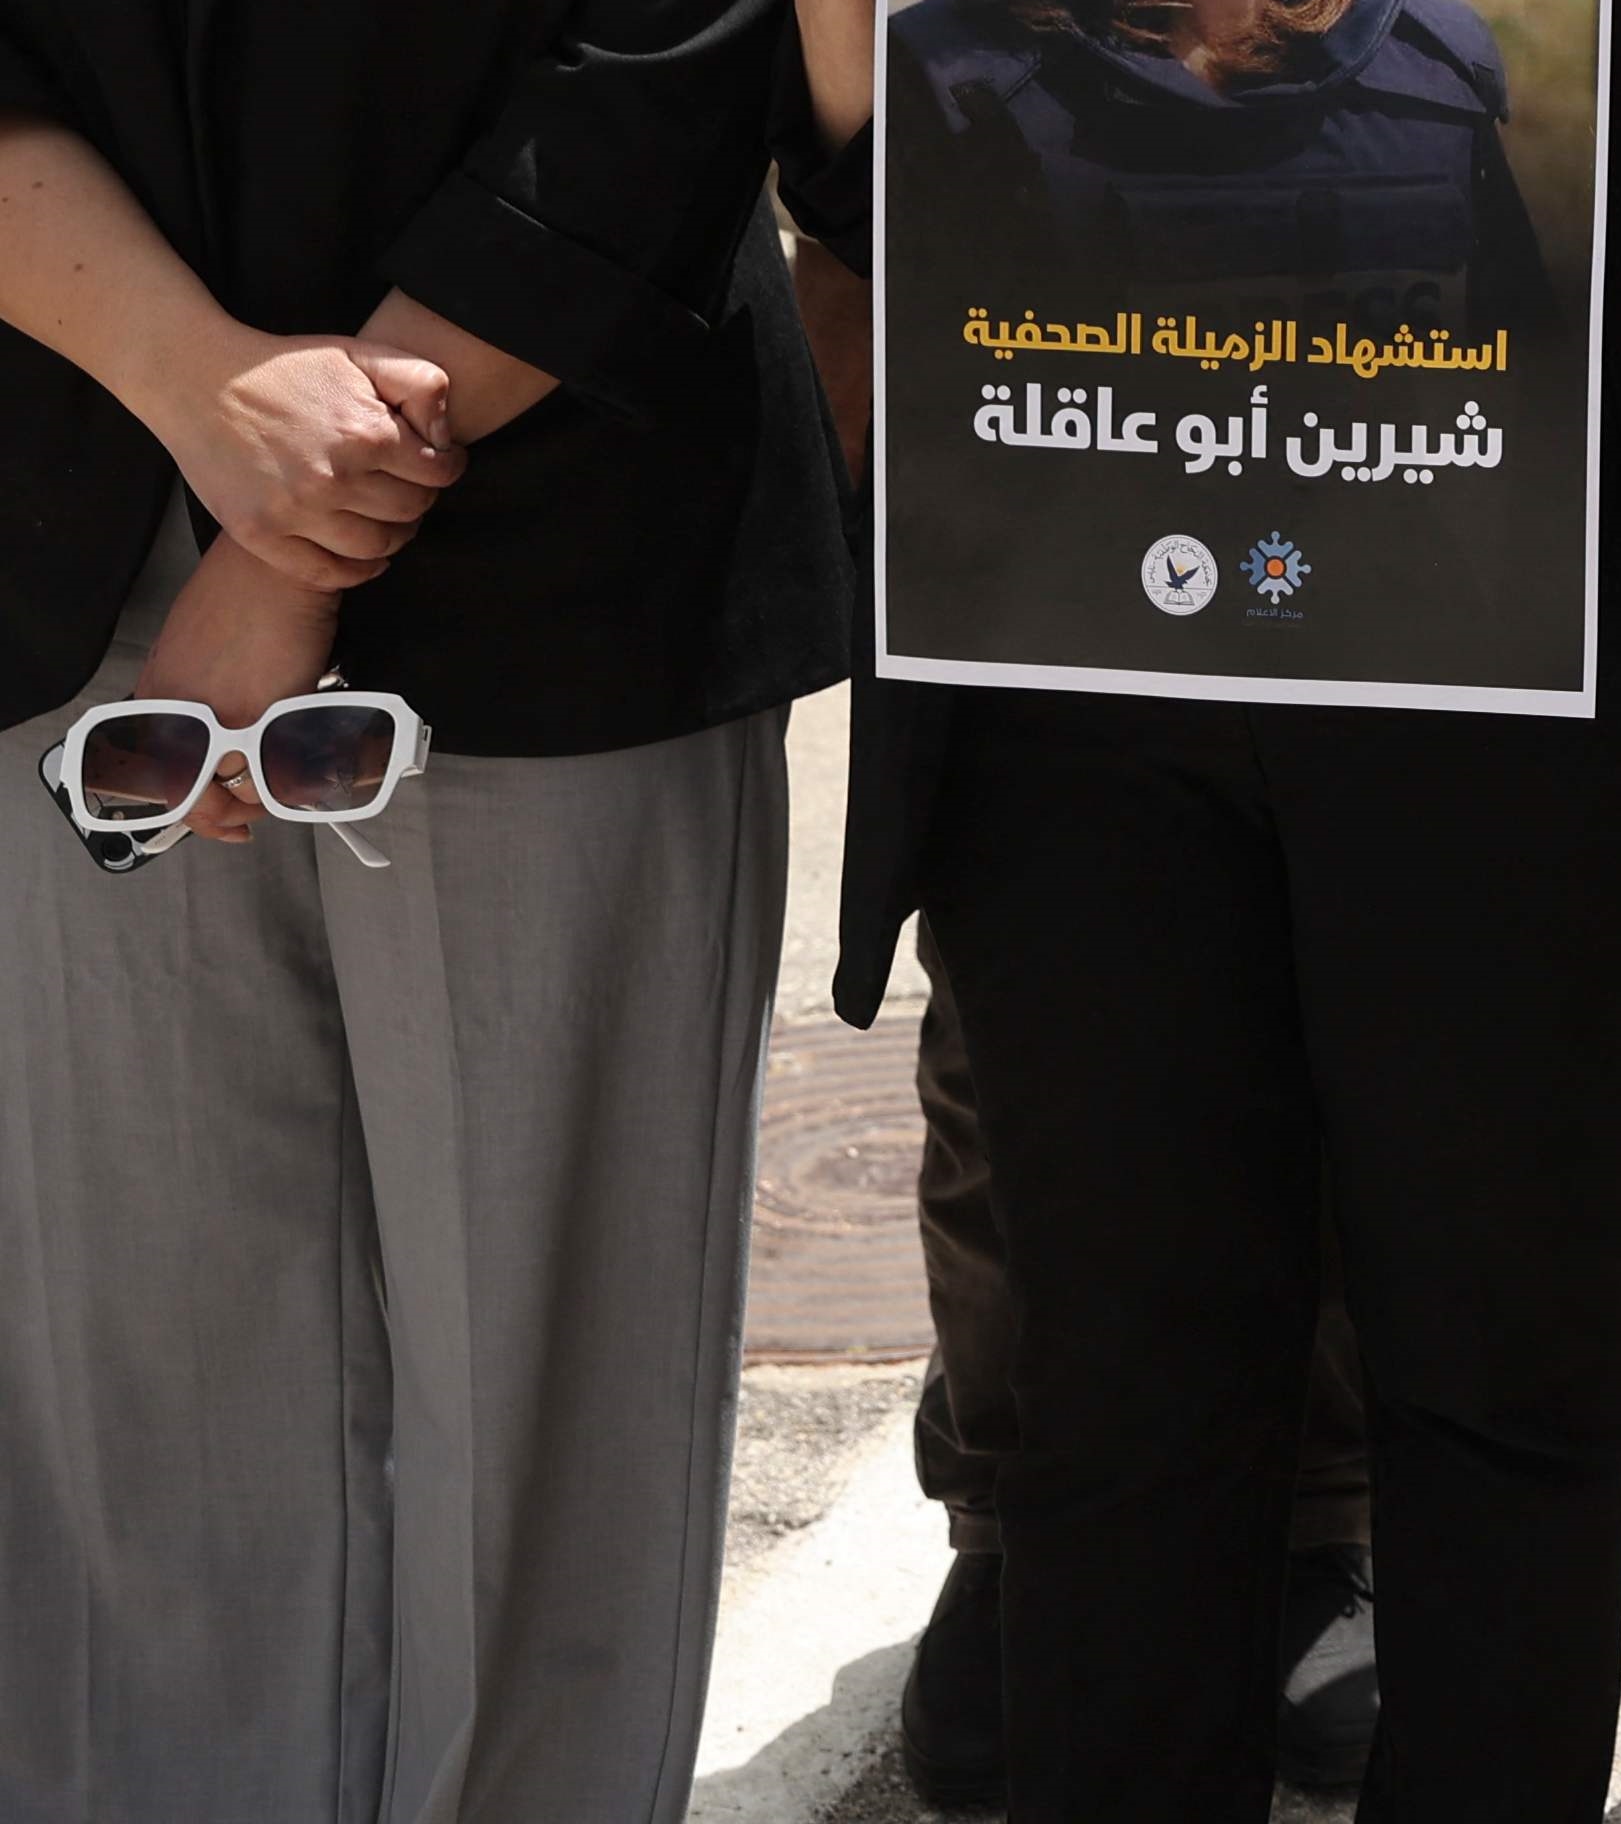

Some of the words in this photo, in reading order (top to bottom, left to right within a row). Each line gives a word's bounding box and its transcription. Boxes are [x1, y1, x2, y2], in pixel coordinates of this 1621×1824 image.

[962, 307, 1142, 360] الصحفية
[1151, 315, 1297, 372] الزميلة
[1306, 322, 1508, 379] استشهاد
[973, 382, 1159, 454] عاقلة
[1175, 384, 1269, 477] أبو
[1285, 400, 1503, 485] شيرين
